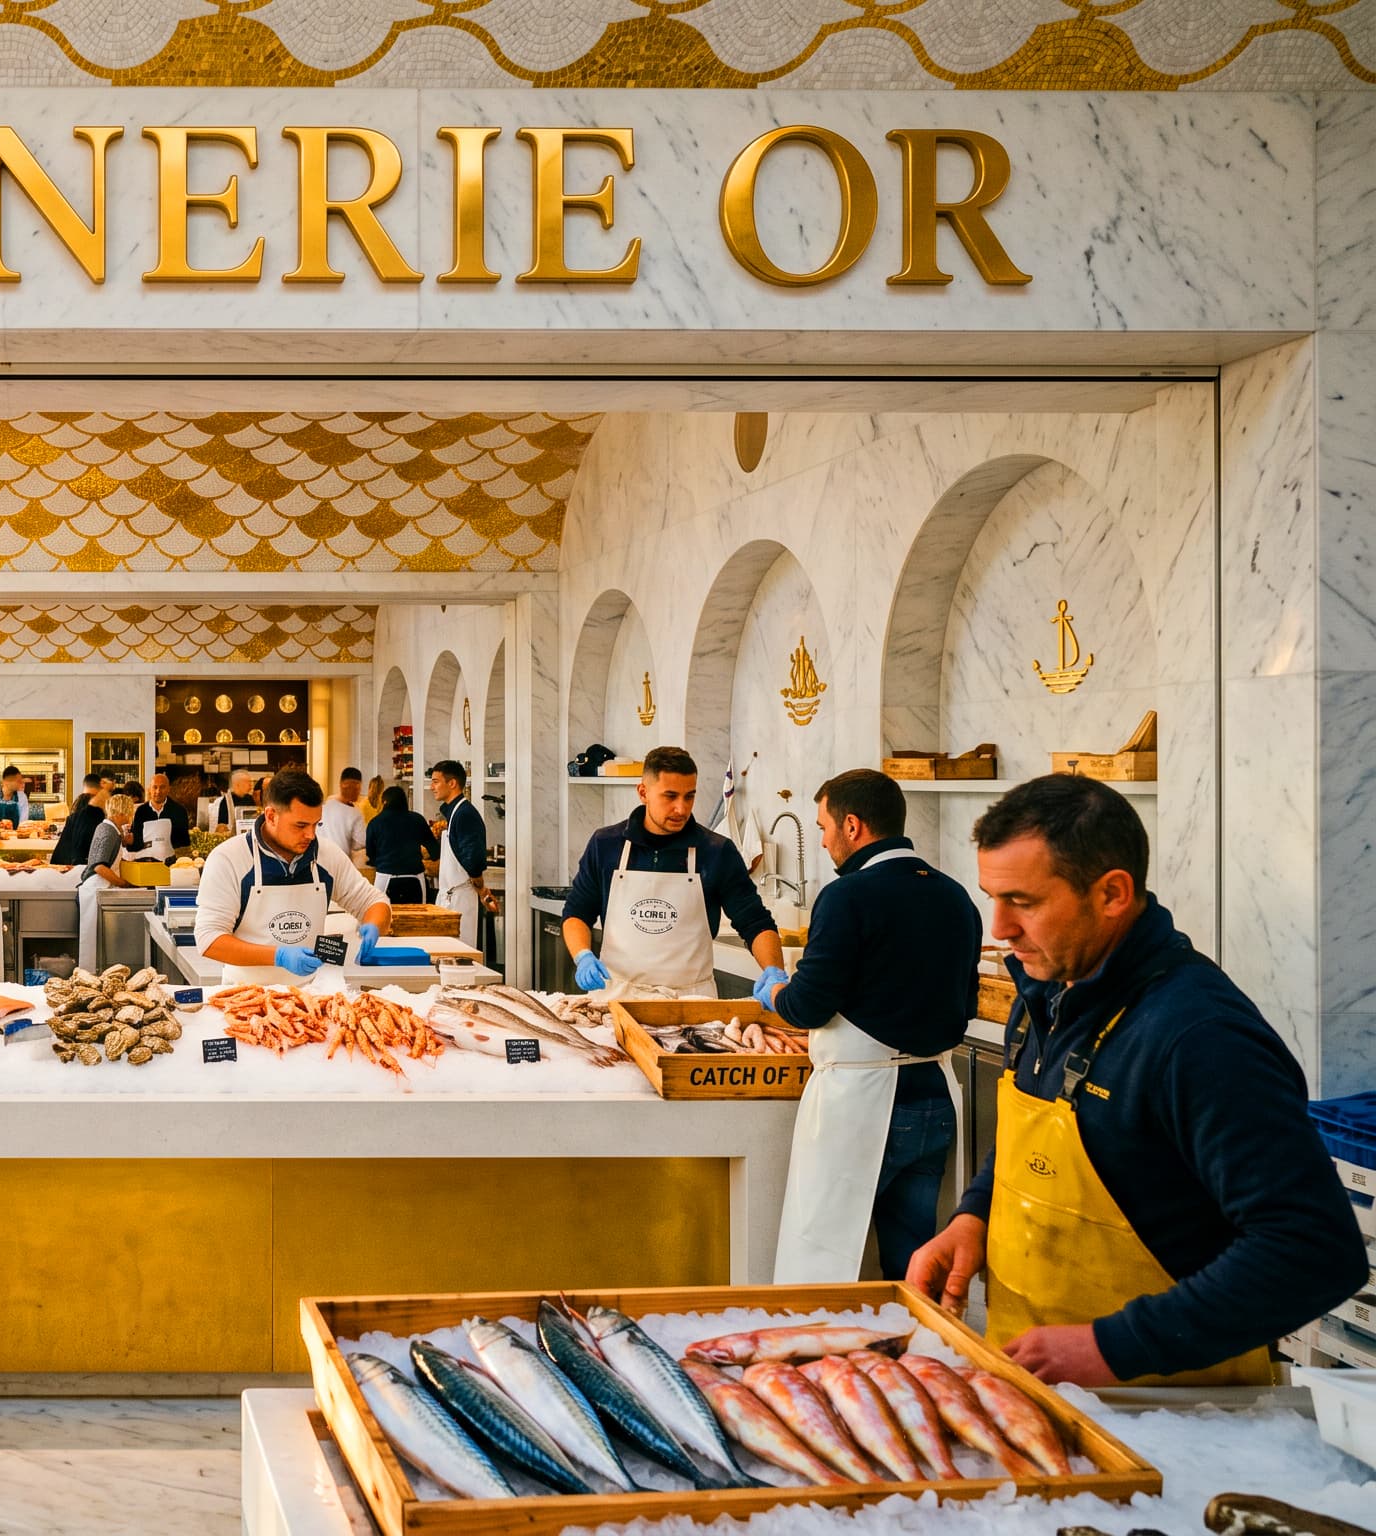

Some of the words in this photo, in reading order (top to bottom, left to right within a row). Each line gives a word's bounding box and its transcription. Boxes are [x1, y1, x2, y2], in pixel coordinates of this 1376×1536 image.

[718, 124, 1033, 288] OR
[690, 1067, 756, 1086] CATCH
[763, 1066, 790, 1085] OF
